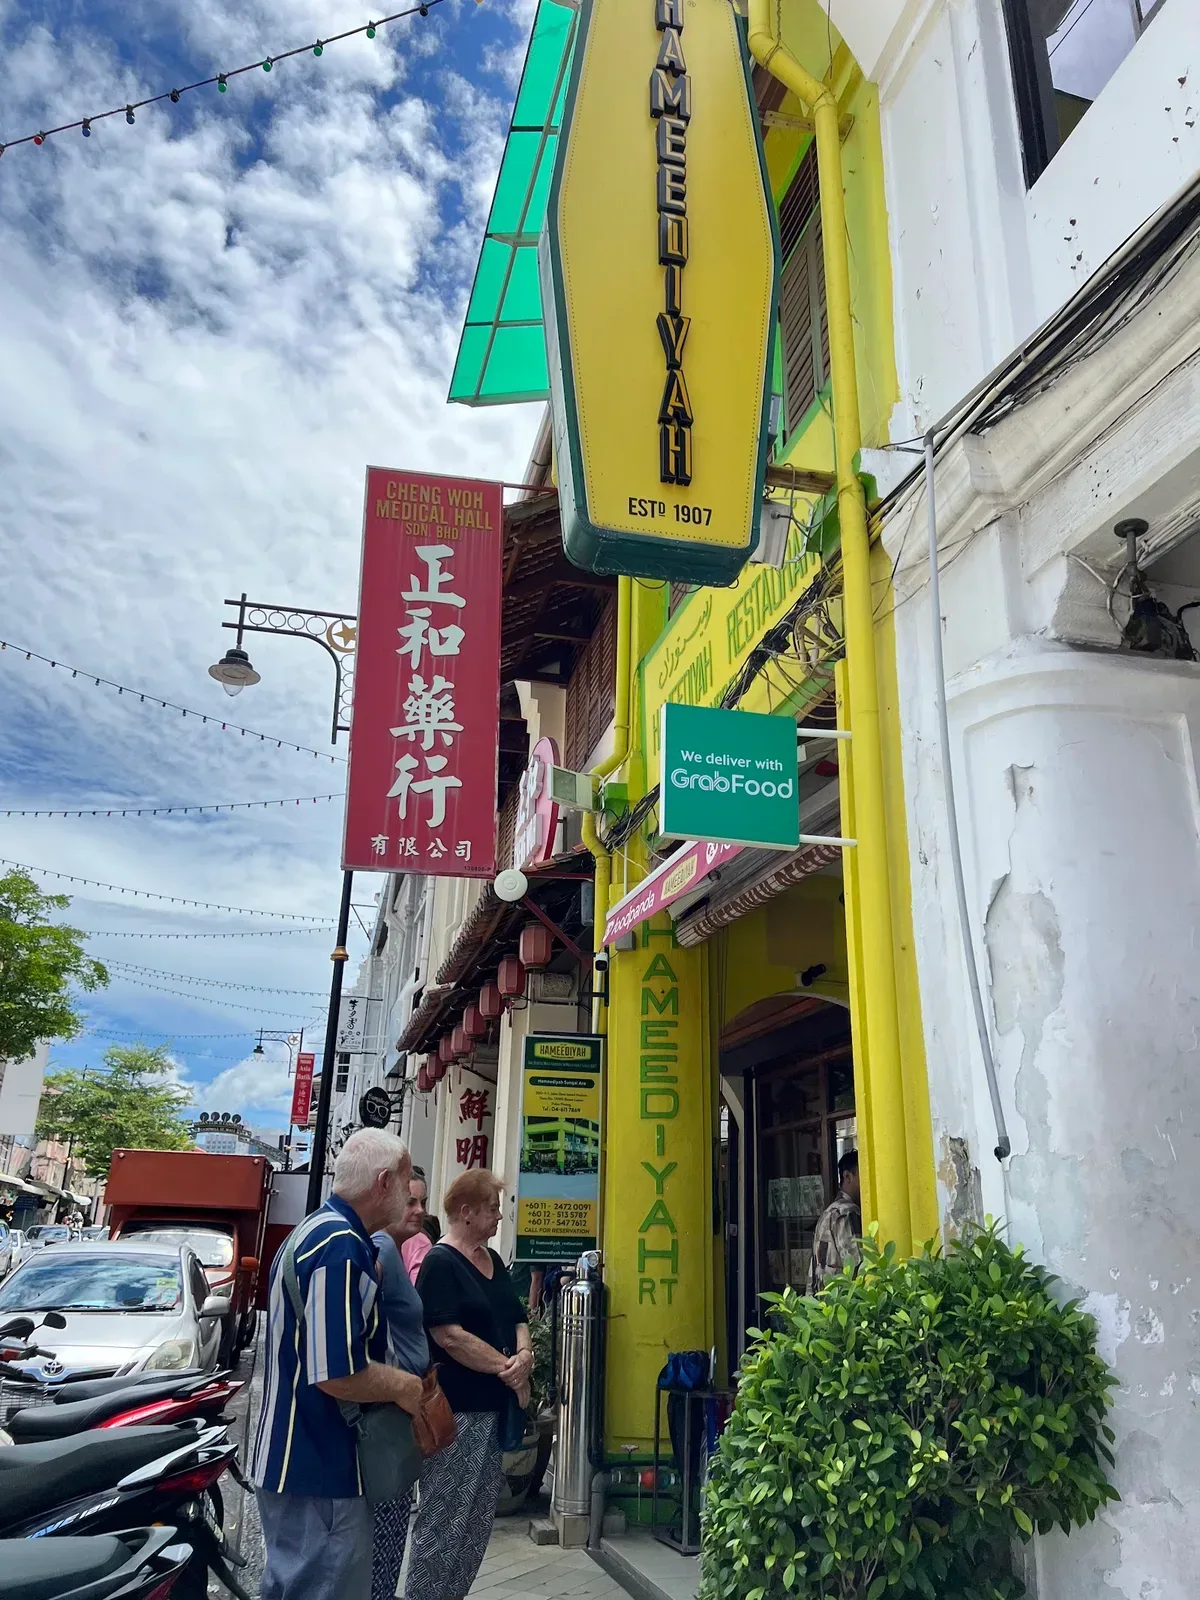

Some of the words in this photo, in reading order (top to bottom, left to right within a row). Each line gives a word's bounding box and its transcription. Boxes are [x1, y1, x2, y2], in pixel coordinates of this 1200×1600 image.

[386, 480, 441, 505] CHENG
[448, 488, 484, 510] WOH
[376, 499, 448, 525] MEDICAL
[454, 507, 493, 530] HALL
[673, 504, 712, 526] 1907
[386, 543, 467, 829] 正和藥行
[680, 750, 702, 763] We
[705, 753, 751, 768] deliver
[755, 759, 783, 772] with
[671, 768, 793, 799] GrabFood
[370, 834, 472, 862] 有限公司
[611, 890, 655, 936] foodpanda
[540, 1045, 586, 1057] HAMEEDIYAH
[637, 919, 680, 1275] HAMEEDIYAH
[455, 1087, 492, 1170] 鮮明
[638, 1277, 679, 1304] RT
[25, 1513, 80, 1540] AVE
